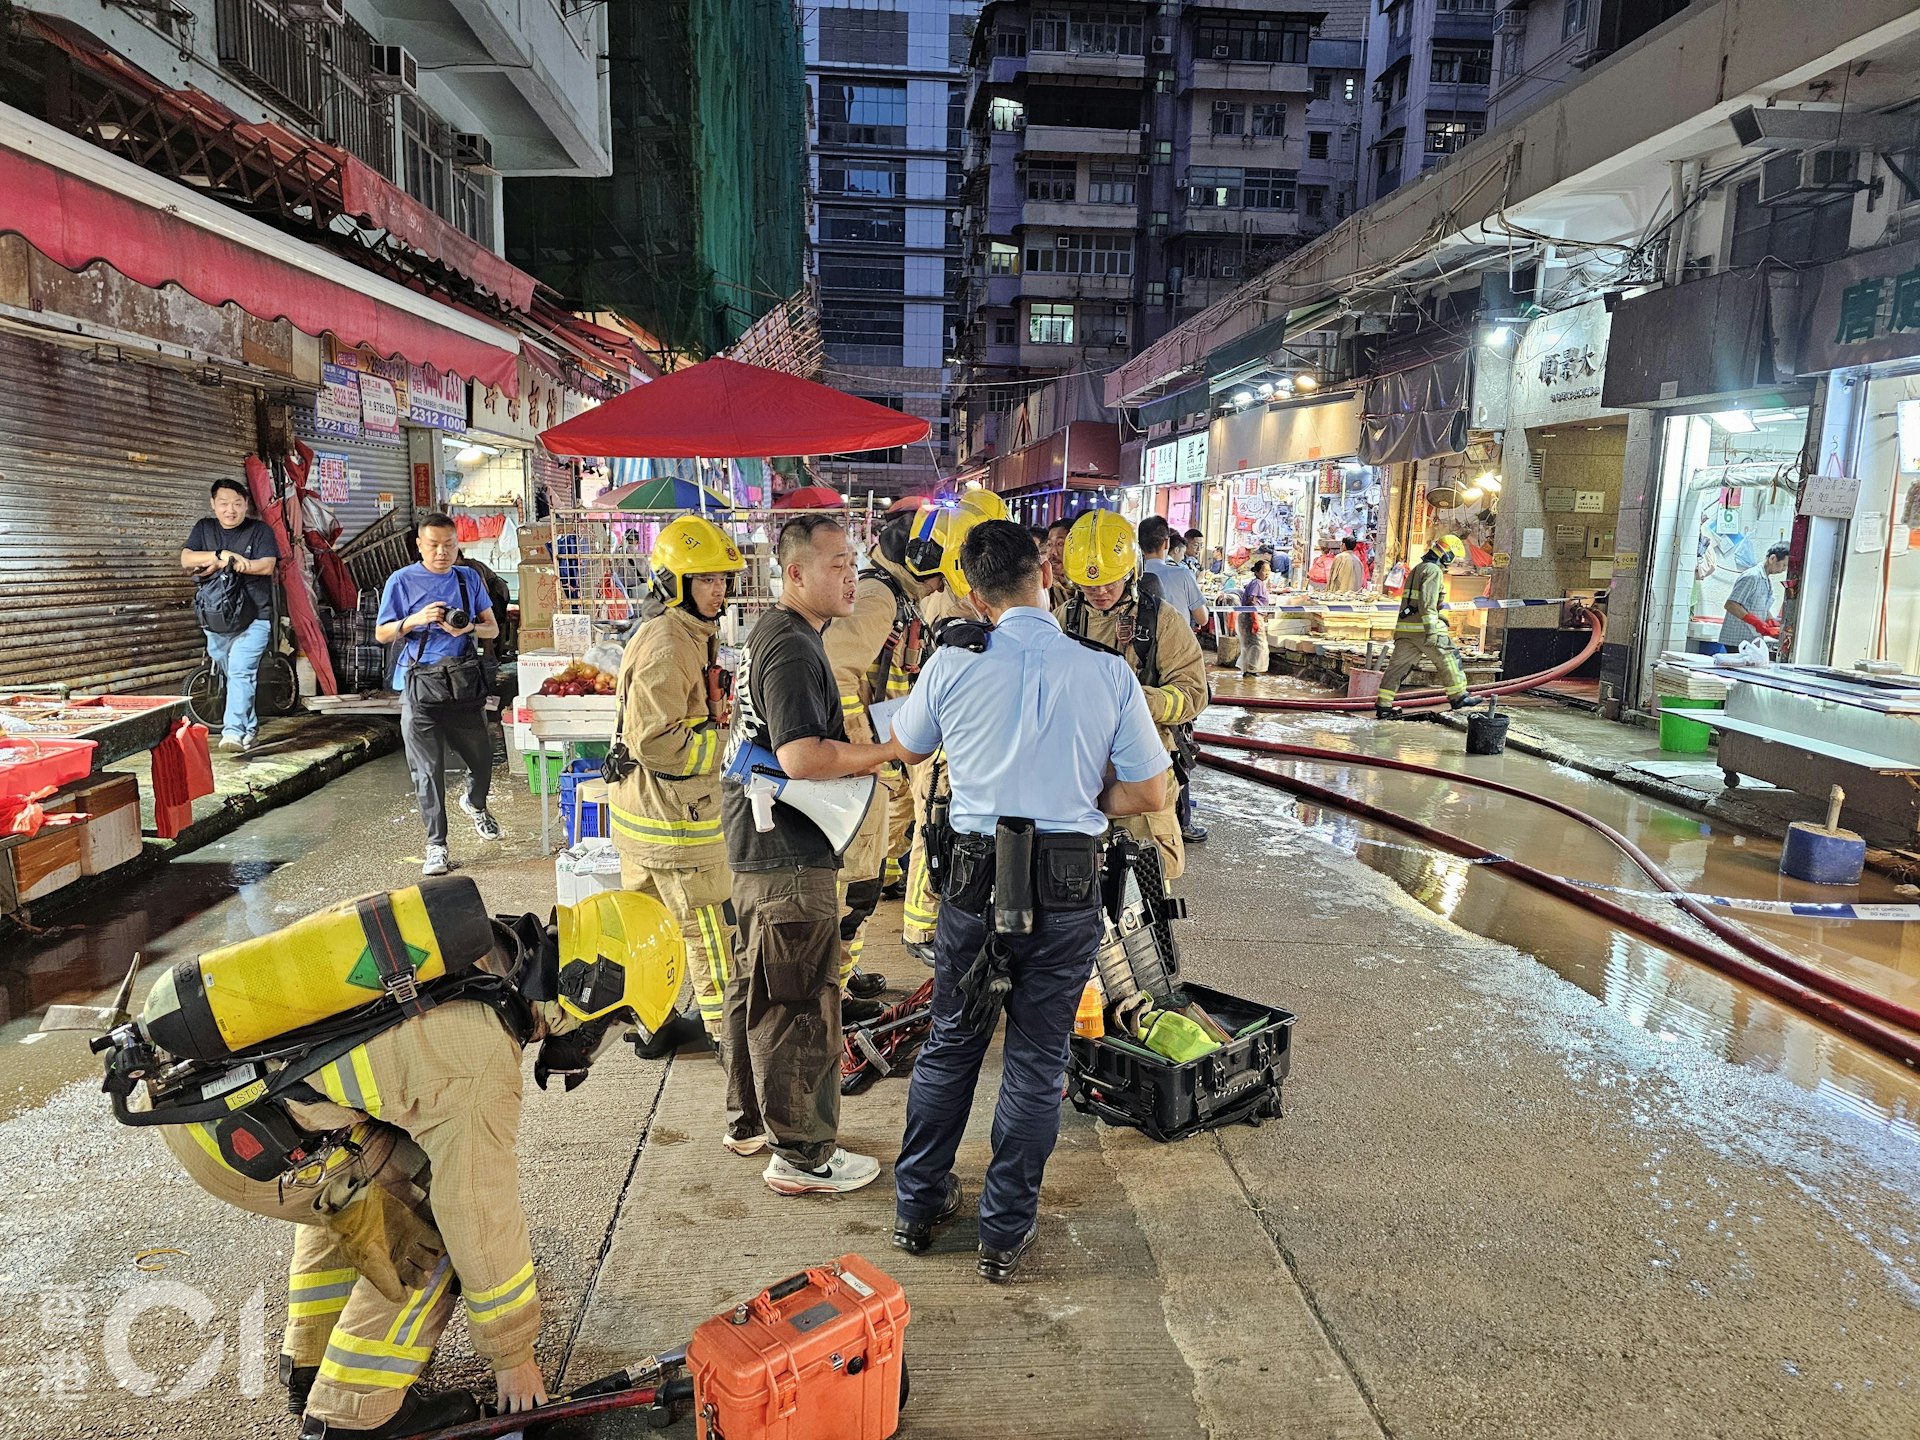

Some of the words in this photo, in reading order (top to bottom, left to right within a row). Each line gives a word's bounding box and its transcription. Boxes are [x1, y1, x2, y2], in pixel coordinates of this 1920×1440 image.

[316, 417, 341, 432] 2721
[411, 408, 438, 425] 2312
[442, 415, 466, 432] 1000
[1724, 509, 1734, 523] 6
[679, 532, 701, 549] TST
[1113, 532, 1127, 555] MTC
[665, 955, 675, 987] TST
